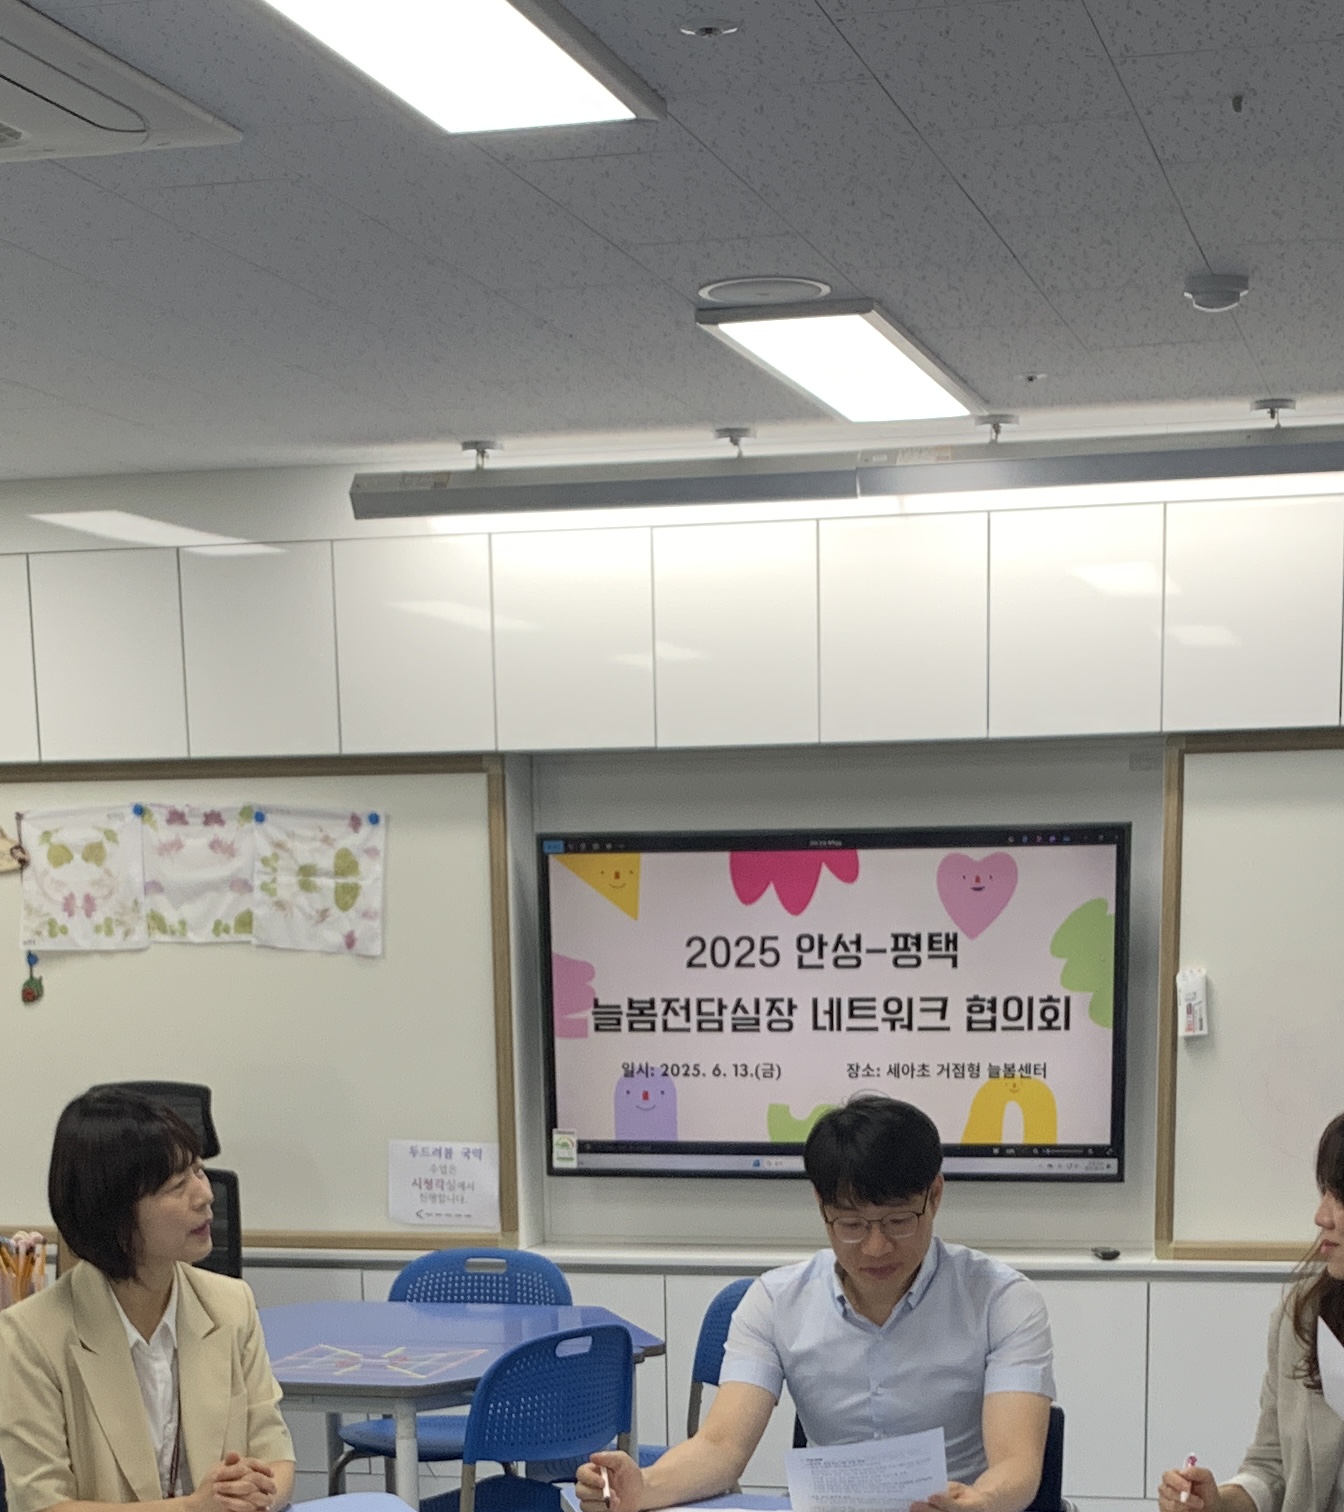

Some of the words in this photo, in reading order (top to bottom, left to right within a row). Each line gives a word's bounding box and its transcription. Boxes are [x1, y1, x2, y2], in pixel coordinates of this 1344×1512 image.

[685, 935, 781, 970] 2025
[795, 931, 959, 970] 안성-평택
[591, 996, 798, 1034] 늘봄전담실장
[811, 995, 951, 1033] 네트워크
[965, 993, 1072, 1033] 협의회
[620, 1062, 656, 1080] 일시:
[659, 1063, 707, 1079] 2025.
[711, 1063, 727, 1079] 6.
[732, 1062, 782, 1080] 13.(금)
[846, 1062, 881, 1079] 장소:
[886, 1062, 931, 1079] 세아초
[936, 1062, 981, 1079] 거점형
[987, 1061, 1047, 1079] 늘봄센터
